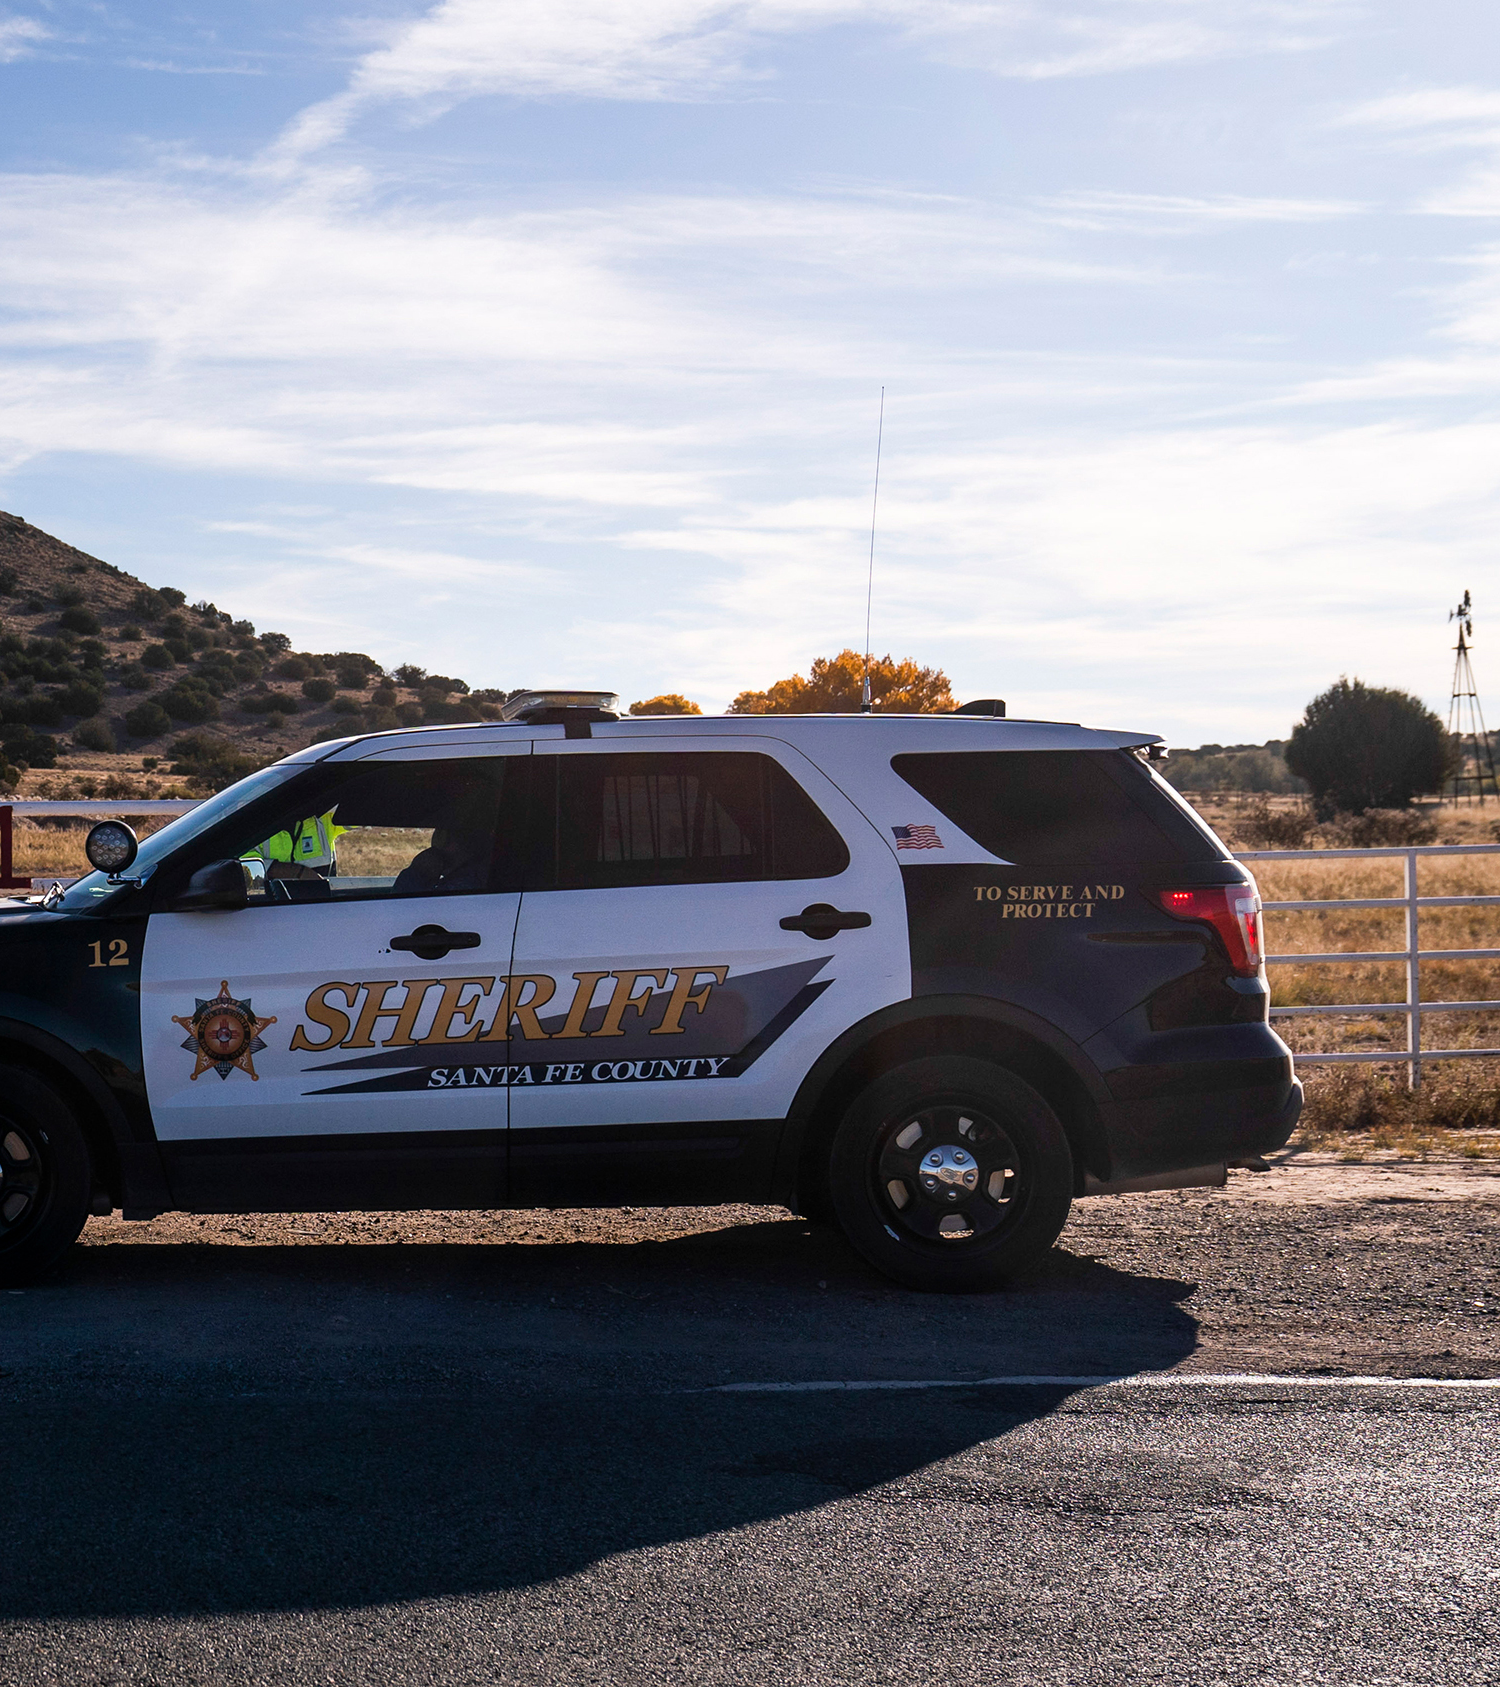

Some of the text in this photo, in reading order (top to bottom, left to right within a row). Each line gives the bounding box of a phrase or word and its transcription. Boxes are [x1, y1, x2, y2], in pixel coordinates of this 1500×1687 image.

[973, 884, 1125, 901] TO SERVE AND
[1001, 902, 1096, 919] PROTECT
[88, 938, 130, 968] 12
[289, 965, 730, 1051] SHERIFF
[427, 1057, 730, 1088] SANTA FE COUNTY
